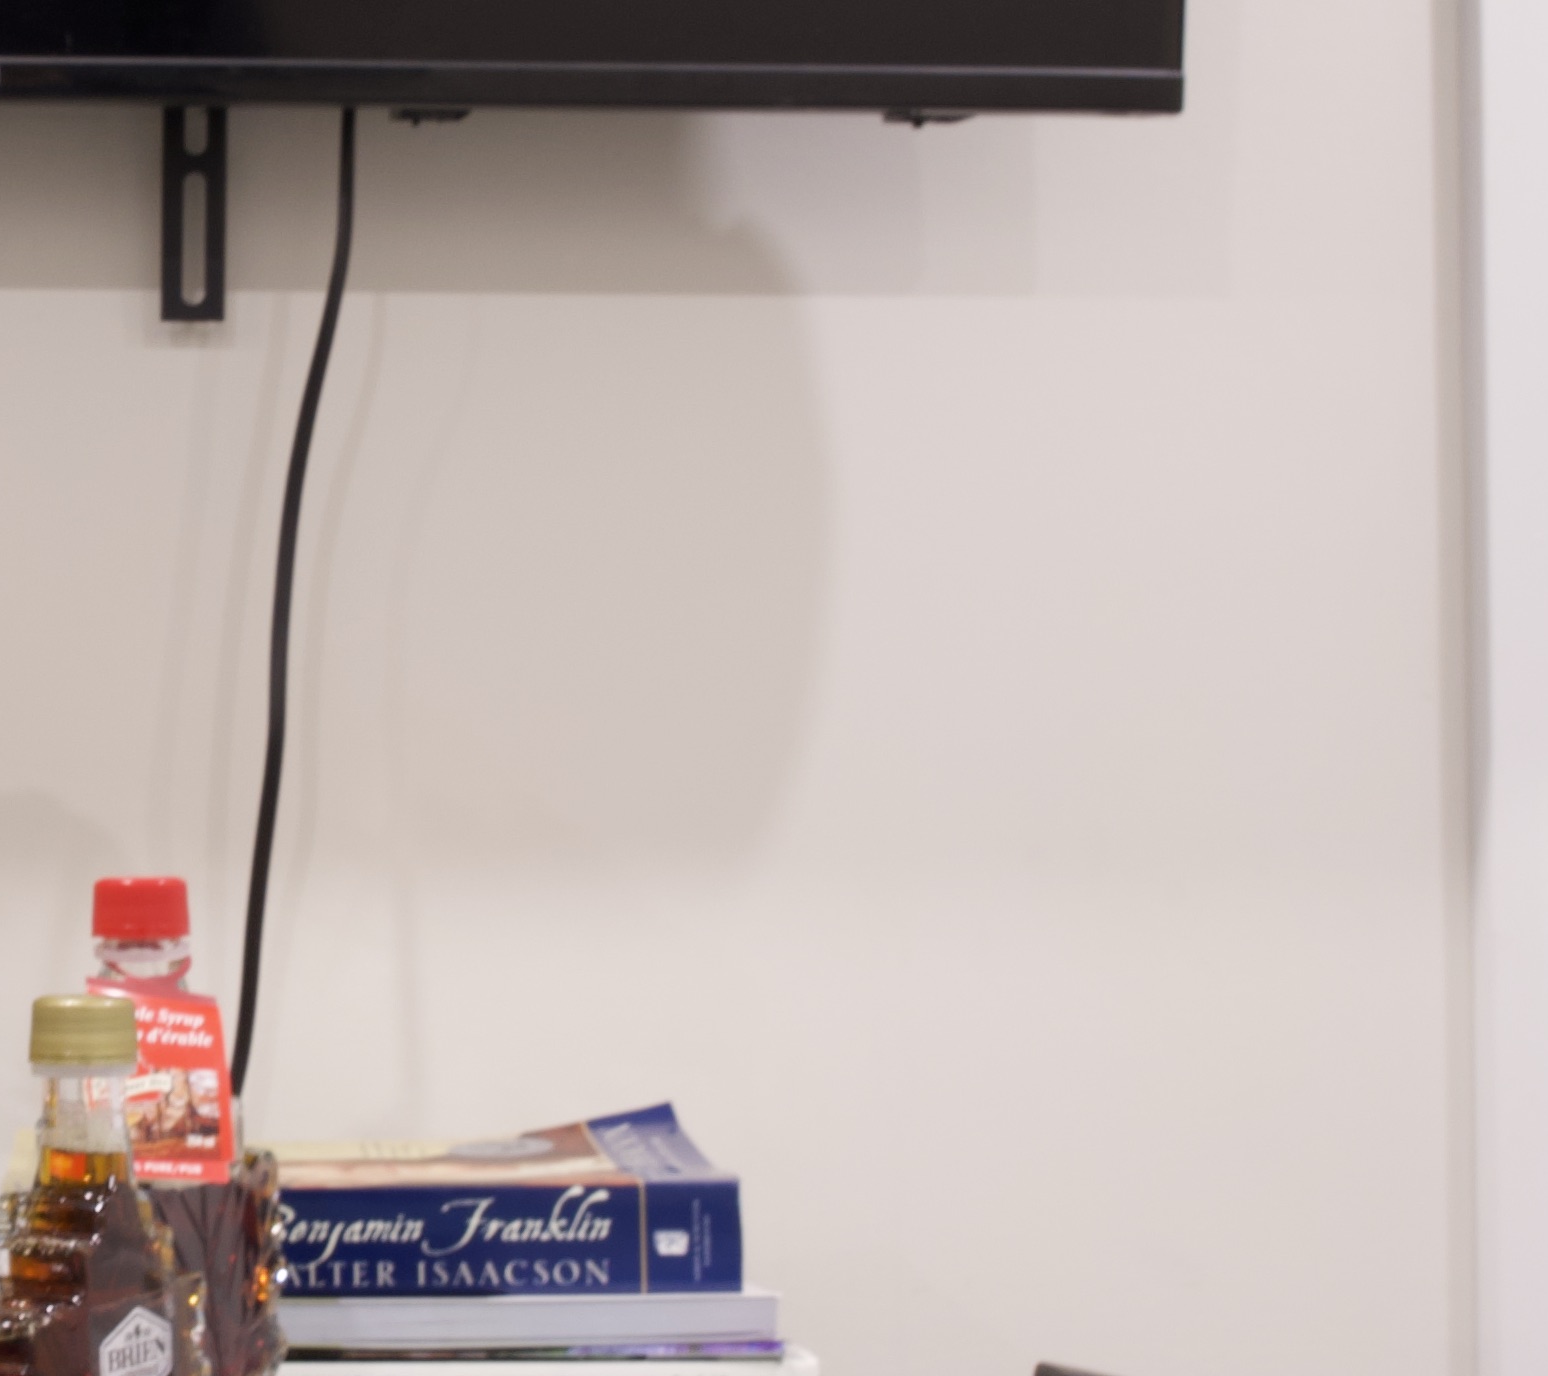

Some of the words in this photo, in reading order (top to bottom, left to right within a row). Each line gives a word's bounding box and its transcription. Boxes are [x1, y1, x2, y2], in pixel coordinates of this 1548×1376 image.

[158, 1008, 205, 1029] Syrup
[278, 1202, 425, 1266] Benjamin
[421, 1184, 612, 1257] Franklin
[285, 1259, 396, 1288] ALTER
[417, 1258, 611, 1288] ISAACSON
[108, 1338, 165, 1372] BRIEN
